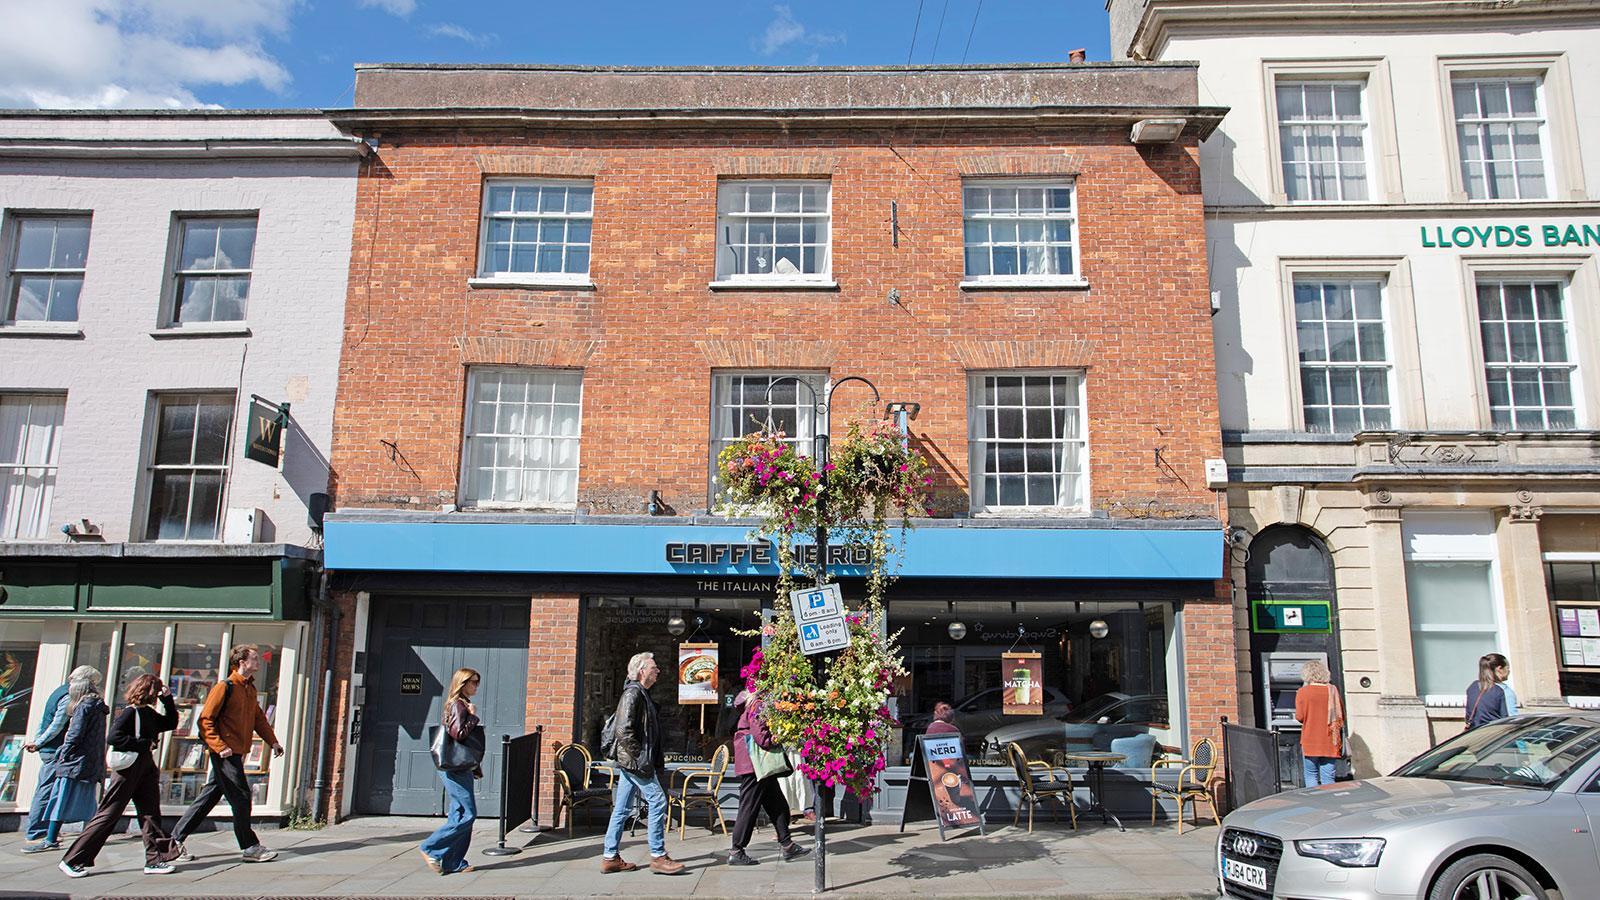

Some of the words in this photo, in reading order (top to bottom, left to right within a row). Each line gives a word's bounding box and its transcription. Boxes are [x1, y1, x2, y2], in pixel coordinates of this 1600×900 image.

[1421, 225, 1532, 248] LLOYDS
[259, 416, 277, 444] W
[697, 581, 719, 591] THE
[722, 581, 771, 592] ITALIAN
[820, 622, 842, 630] Loading
[1004, 680, 1041, 688] MATCHA
[930, 746, 957, 756] NERO
[946, 810, 973, 822] LATTE
[1246, 866, 1264, 886] CRX
